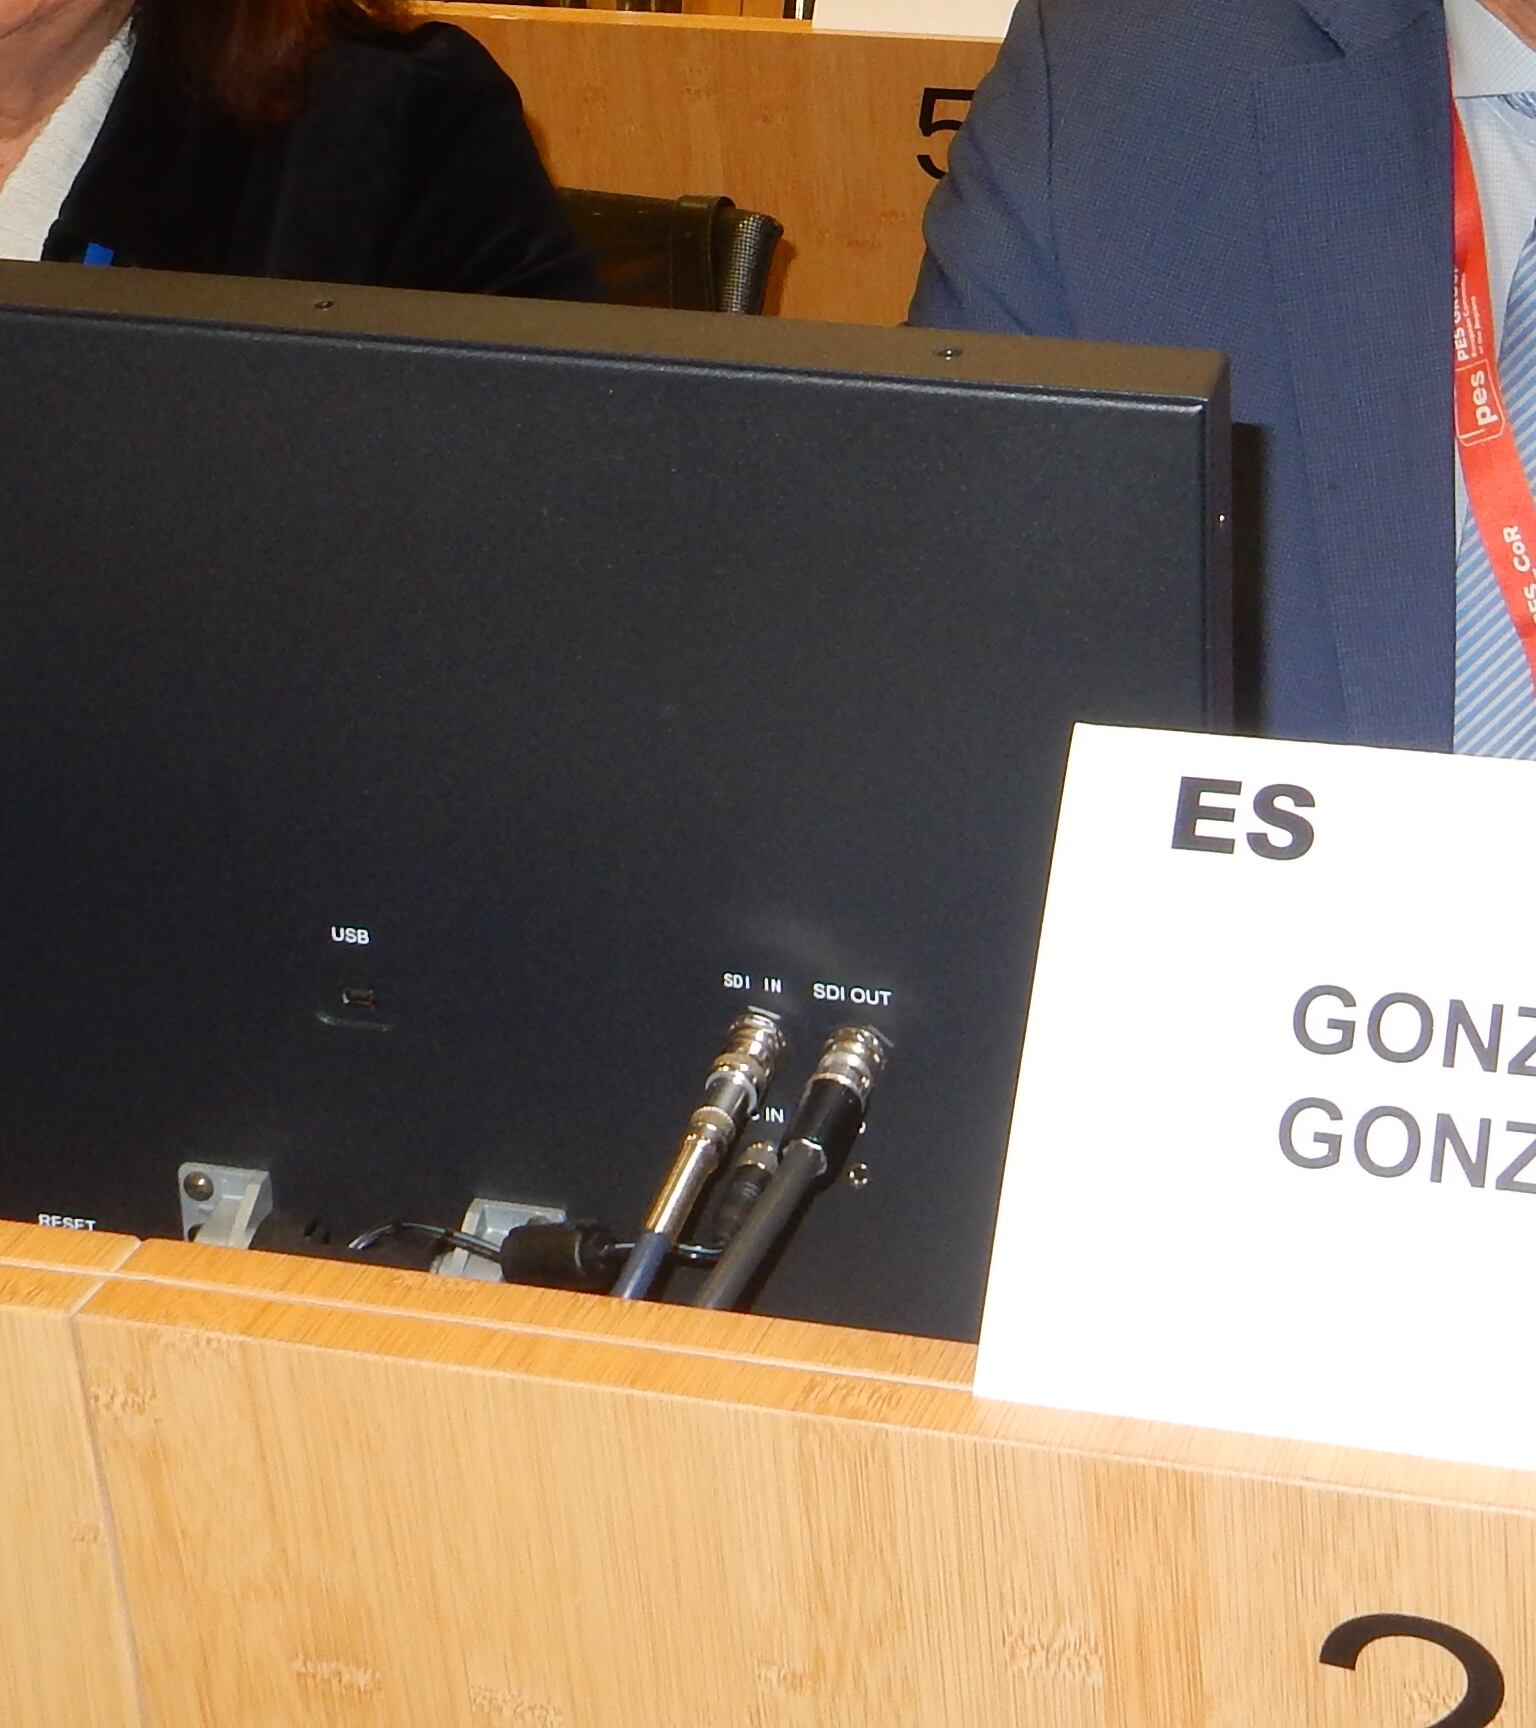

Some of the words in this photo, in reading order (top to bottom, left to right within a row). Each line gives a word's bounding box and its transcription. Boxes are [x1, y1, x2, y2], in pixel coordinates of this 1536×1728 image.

[1470, 369, 1499, 426] pes
[1170, 775, 1317, 862] ES
[330, 925, 370, 945] USB
[723, 972, 751, 990] SDI
[763, 977, 782, 994] IN
[813, 983, 845, 1002] SDI
[850, 987, 893, 1007] OUT
[38, 1213, 97, 1232] RESET
